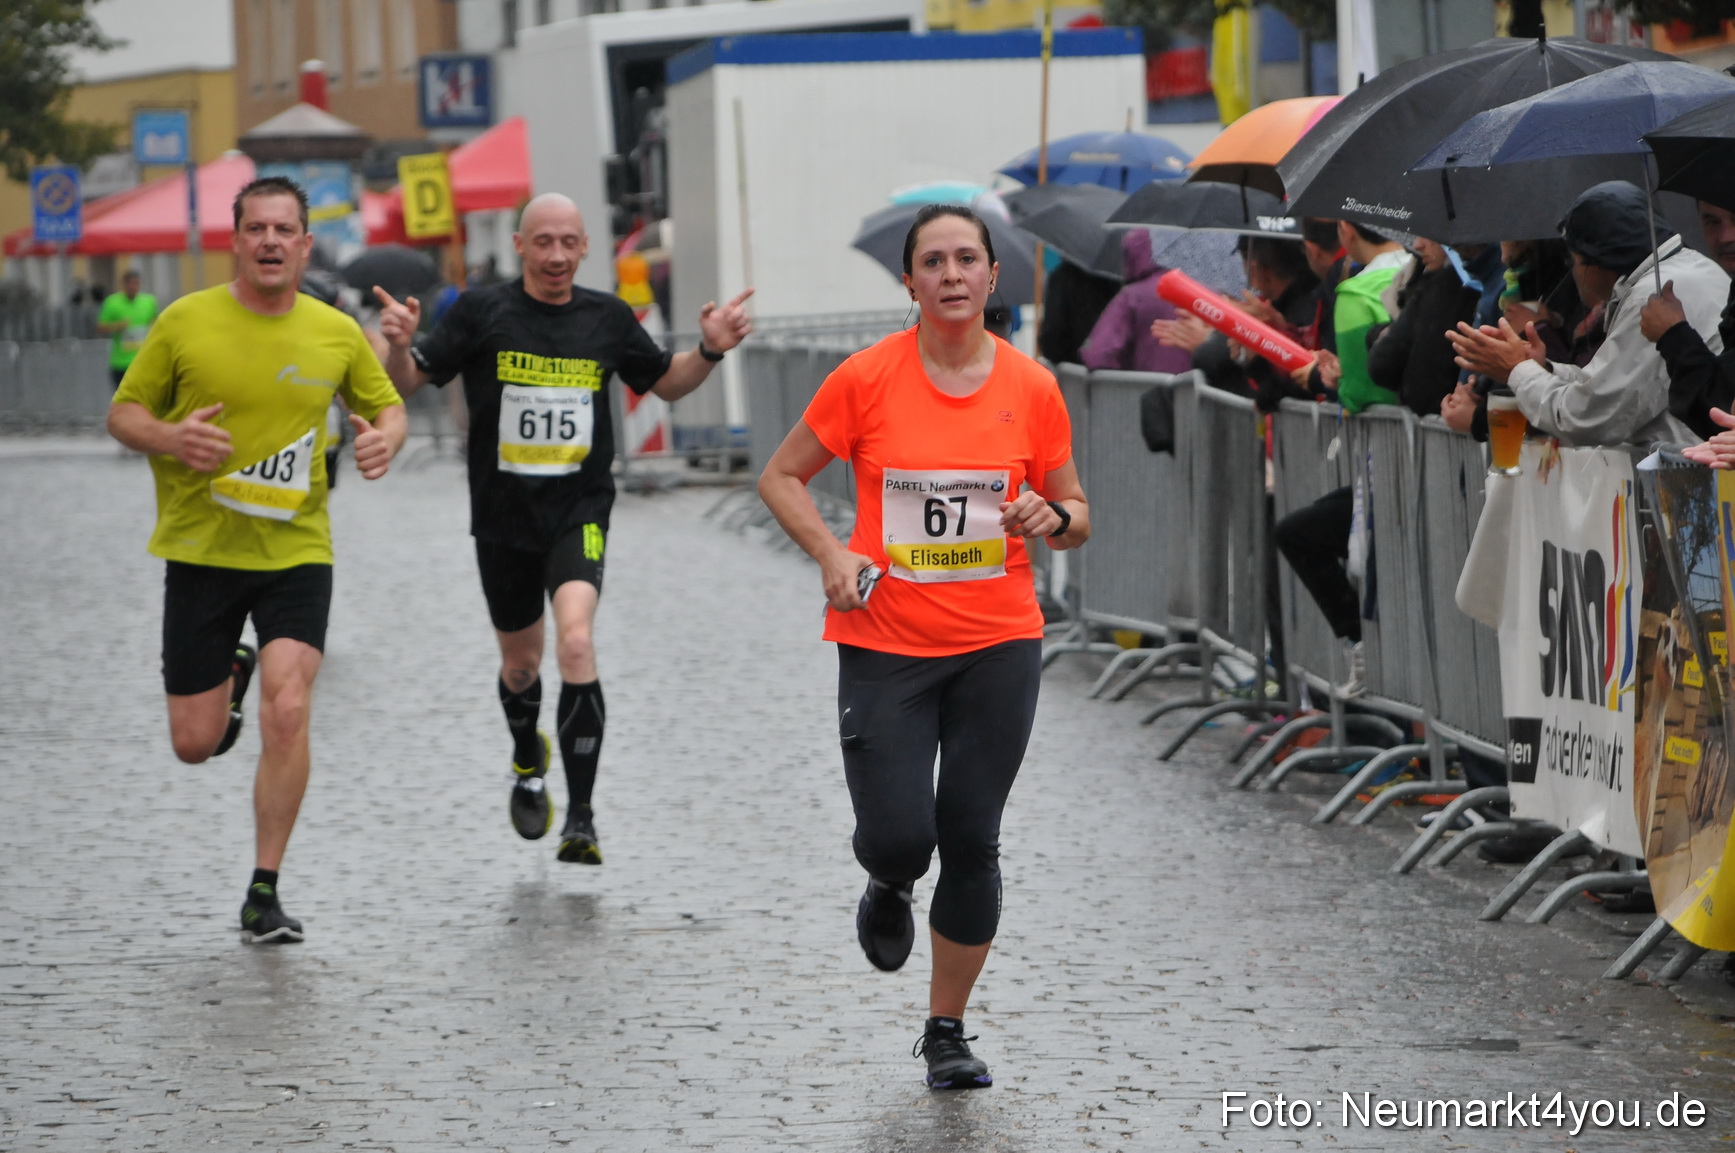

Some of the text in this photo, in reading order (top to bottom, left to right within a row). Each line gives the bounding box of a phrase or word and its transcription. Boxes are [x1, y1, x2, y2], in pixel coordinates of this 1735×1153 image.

[415, 179, 441, 216] D
[1344, 197, 1412, 220] Bierschneider
[519, 408, 576, 440] 615
[885, 479, 986, 493] PARTL Neumarkt
[923, 496, 968, 538] 67
[911, 547, 982, 566] Elisabeth
